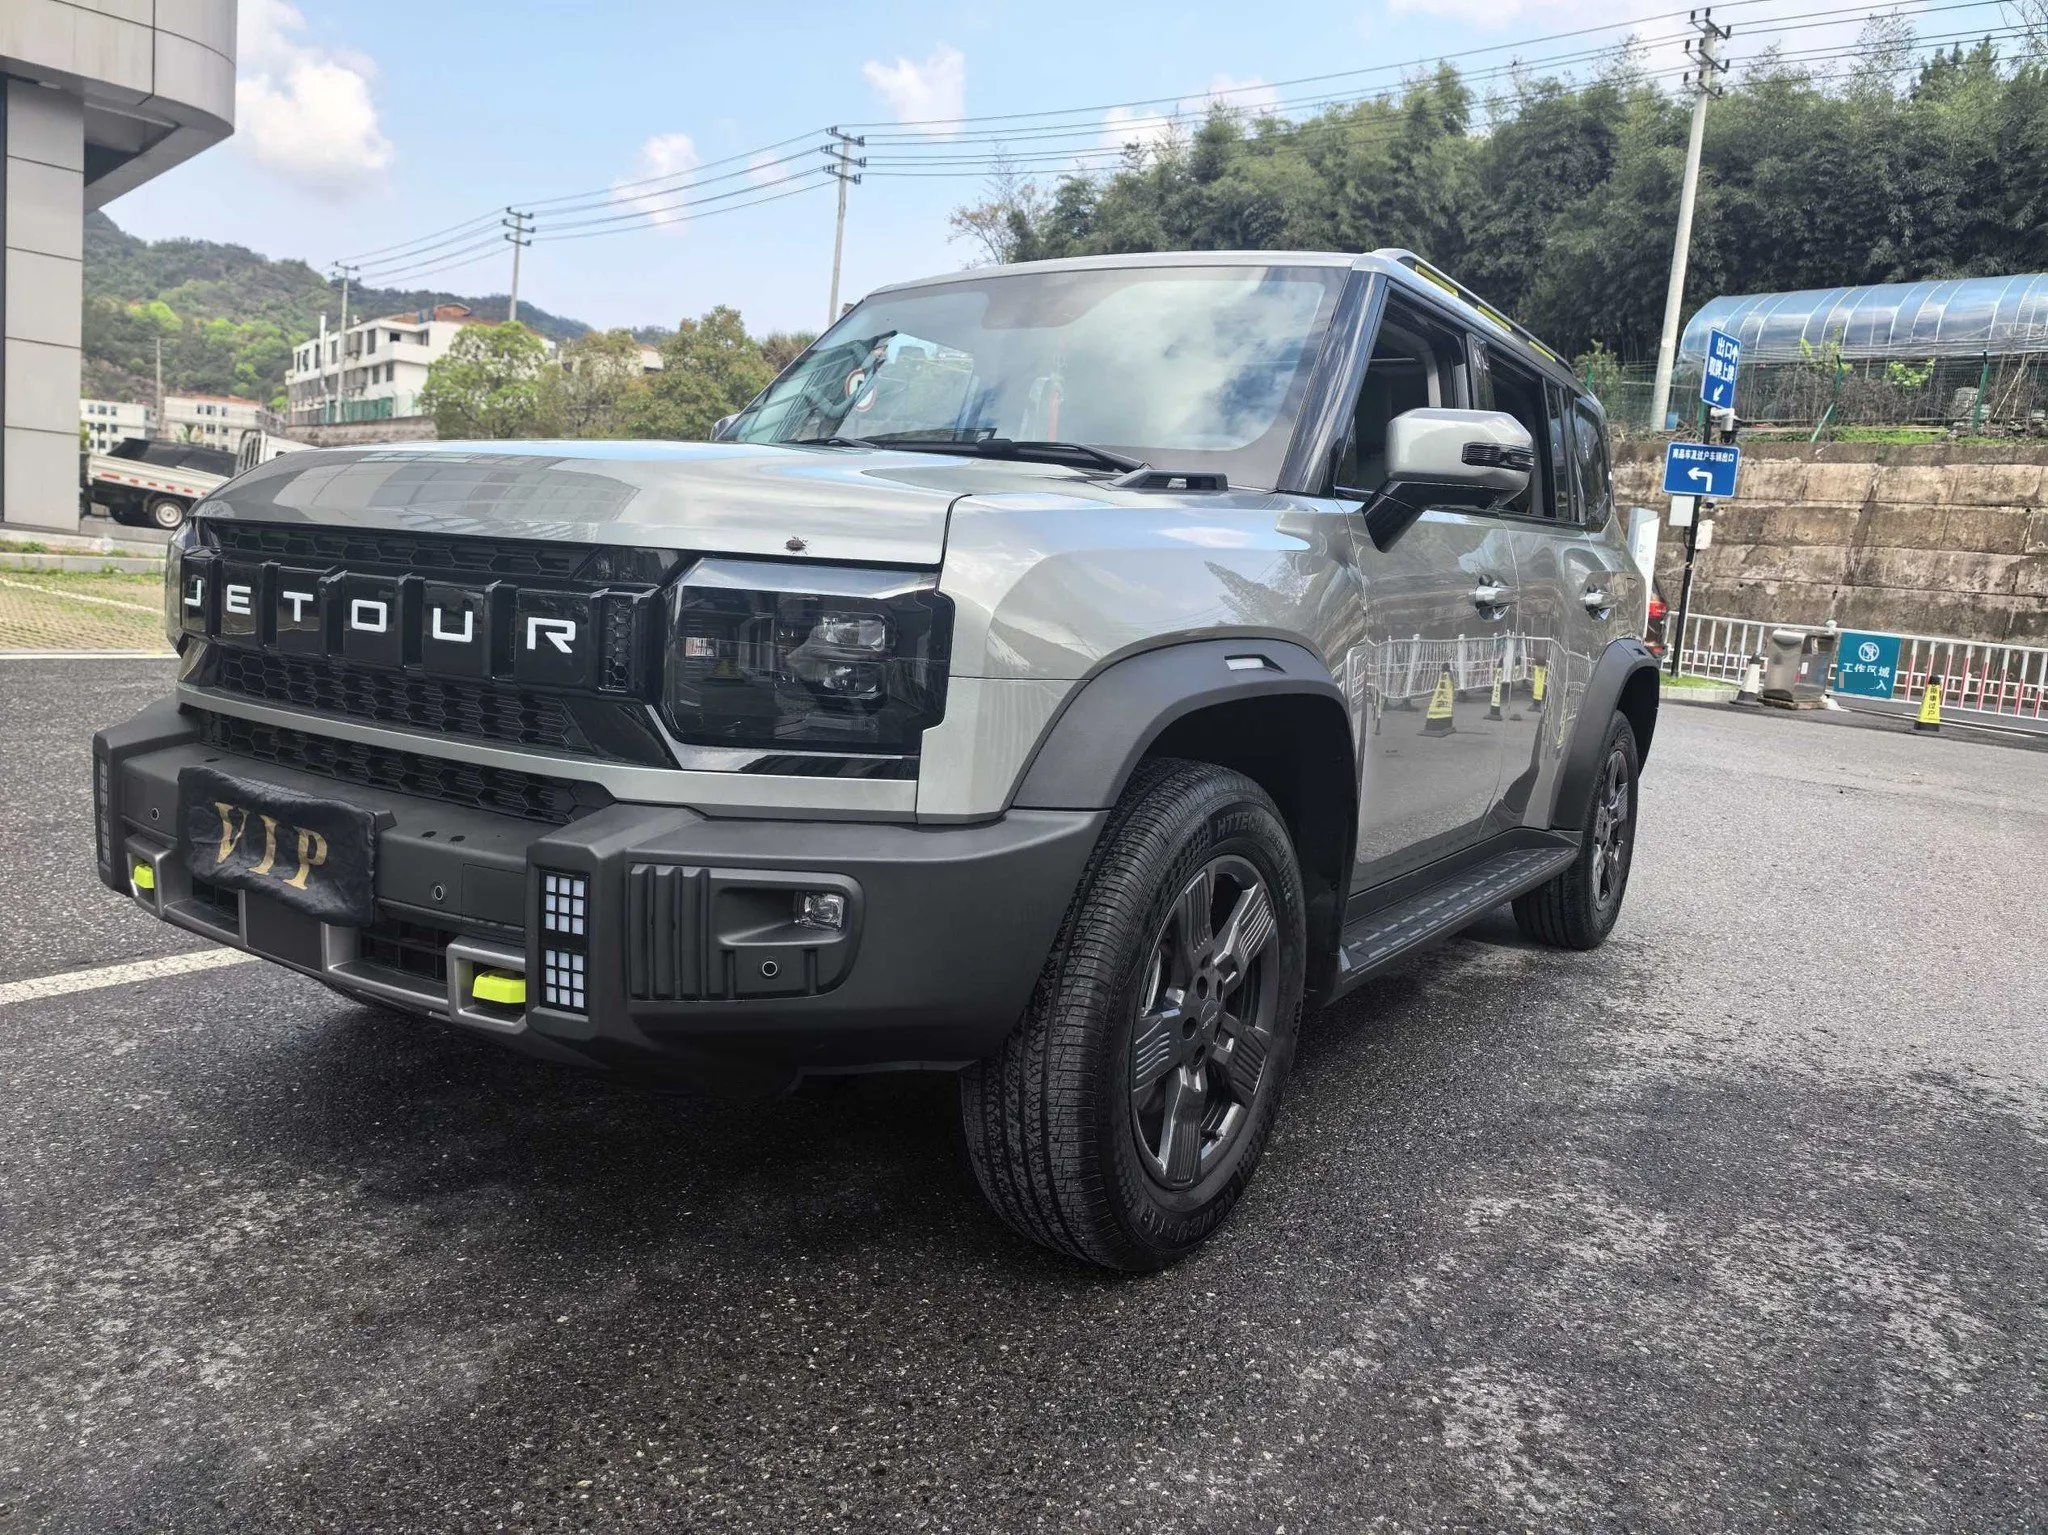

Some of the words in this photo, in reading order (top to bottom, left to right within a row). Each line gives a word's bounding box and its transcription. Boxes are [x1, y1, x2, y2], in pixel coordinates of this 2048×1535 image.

[1716, 336, 1733, 360] 出口
[184, 579, 576, 653] JETOUR
[1842, 662, 1890, 678] 工作区域
[215, 801, 328, 890] VIP
